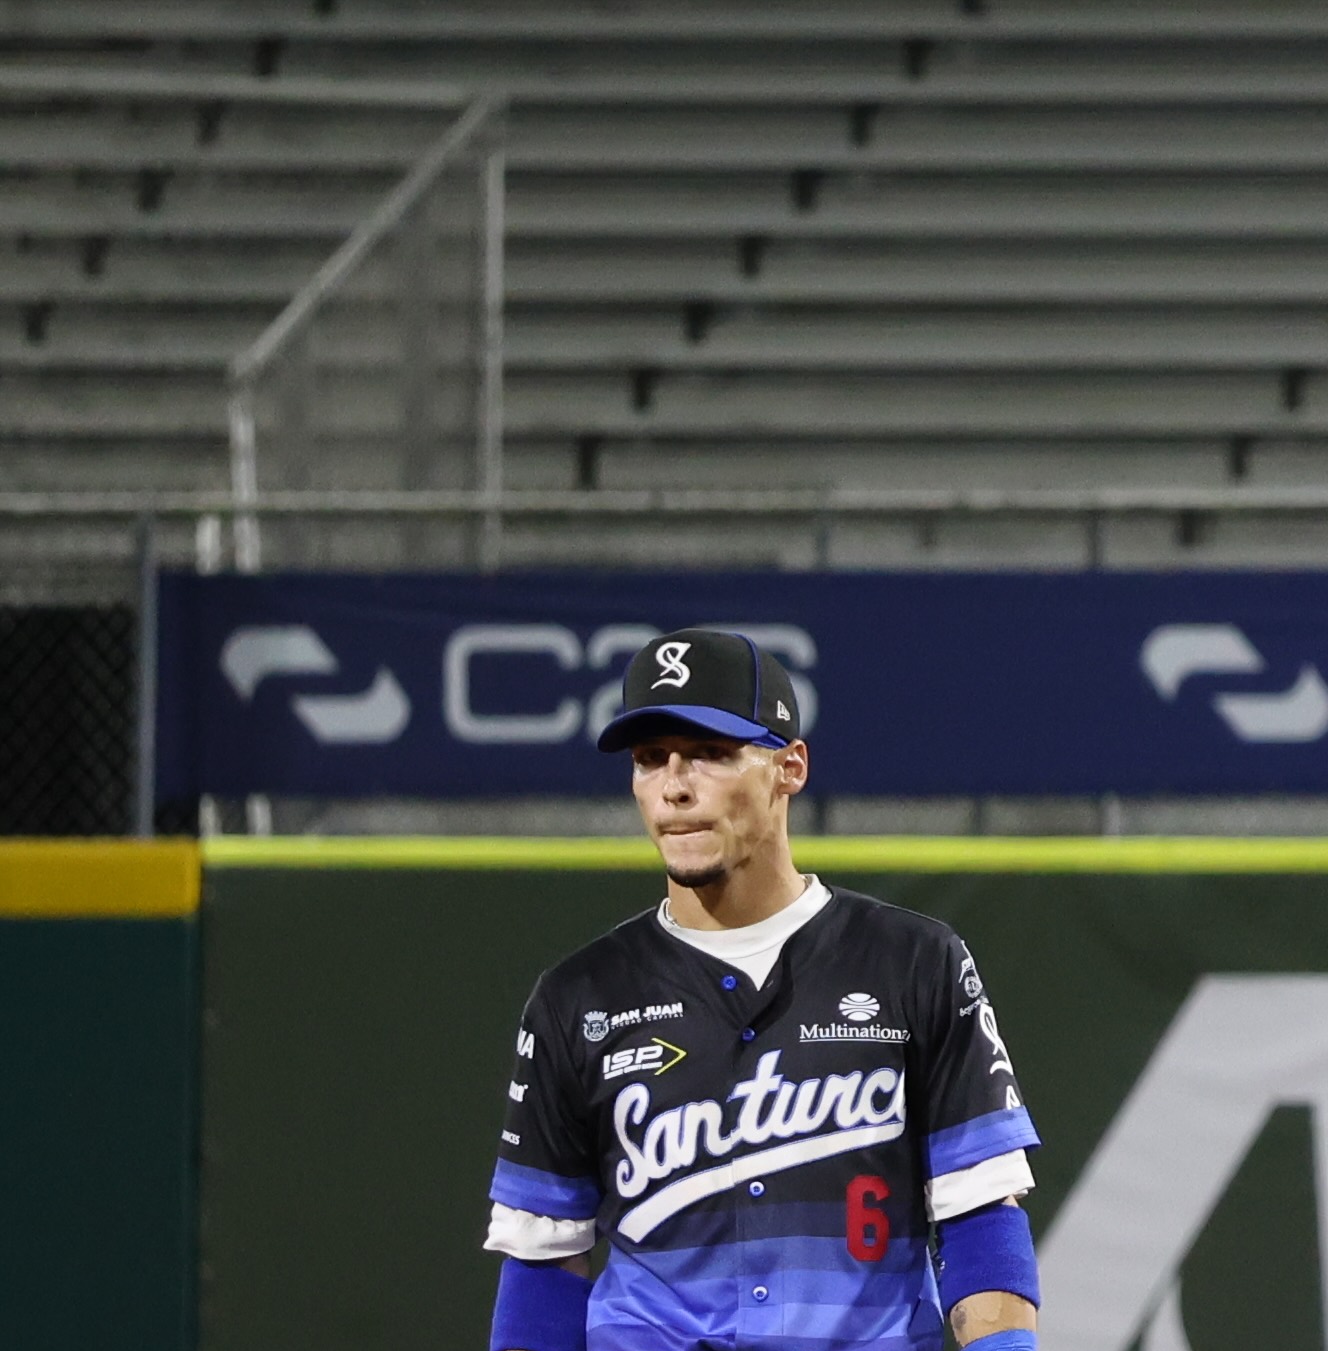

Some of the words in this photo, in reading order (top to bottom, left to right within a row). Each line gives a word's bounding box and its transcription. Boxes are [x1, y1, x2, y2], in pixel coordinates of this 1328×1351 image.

[611, 1008, 640, 1026] SAN
[643, 1002, 684, 1018] JUAN
[603, 1044, 664, 1074] ISP
[845, 1174, 893, 1263] 6
